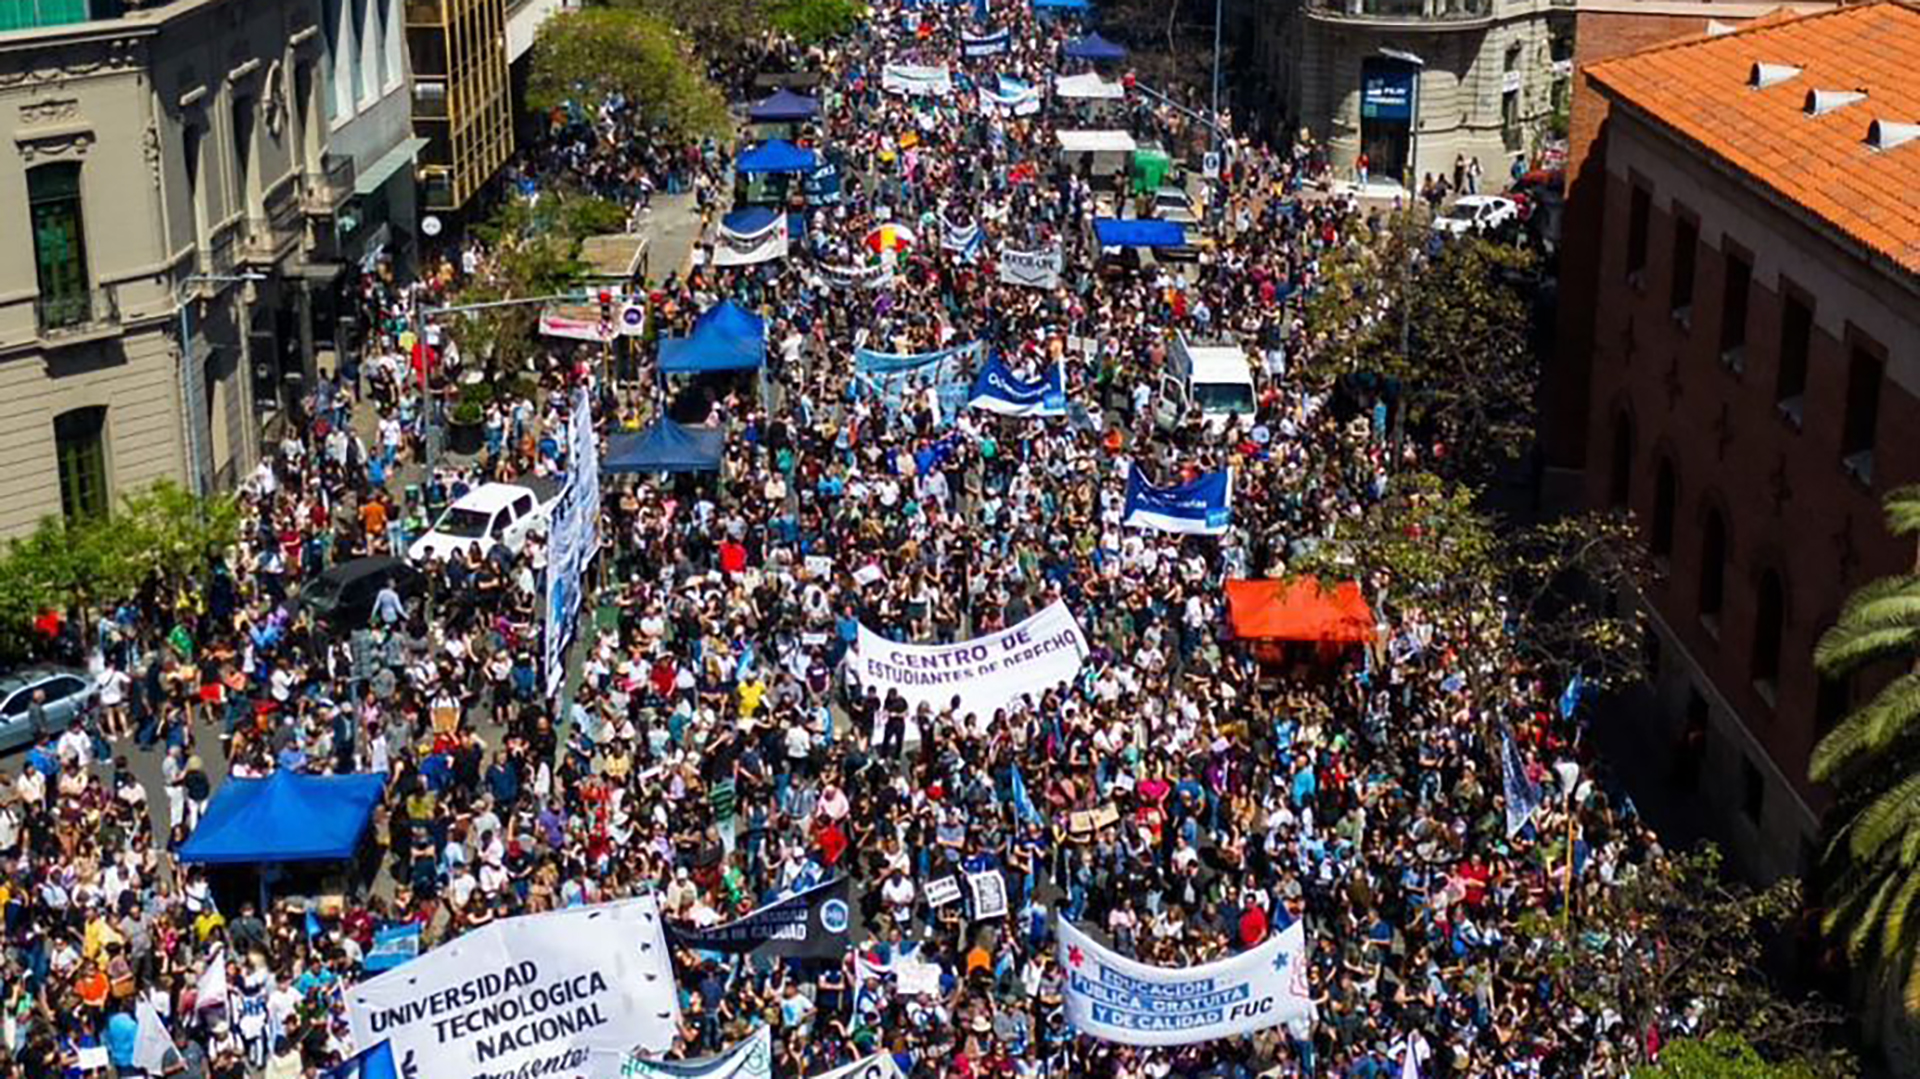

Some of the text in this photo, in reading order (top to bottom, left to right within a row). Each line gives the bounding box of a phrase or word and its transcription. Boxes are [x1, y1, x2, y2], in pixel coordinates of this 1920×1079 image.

[868, 629, 1076, 685] ESTUDIANTES DE DERECHO
[890, 627, 1032, 669] CENTRO DE
[370, 960, 538, 1033] UNIVERSIDAD
[433, 971, 607, 1044] TECNOLOGICA
[1096, 1007, 1220, 1030] Y DE CALIDAD
[1152, 987, 1244, 1013] GRATUITA
[1230, 997, 1274, 1021] FUC
[476, 1002, 608, 1063] NACIONAL
